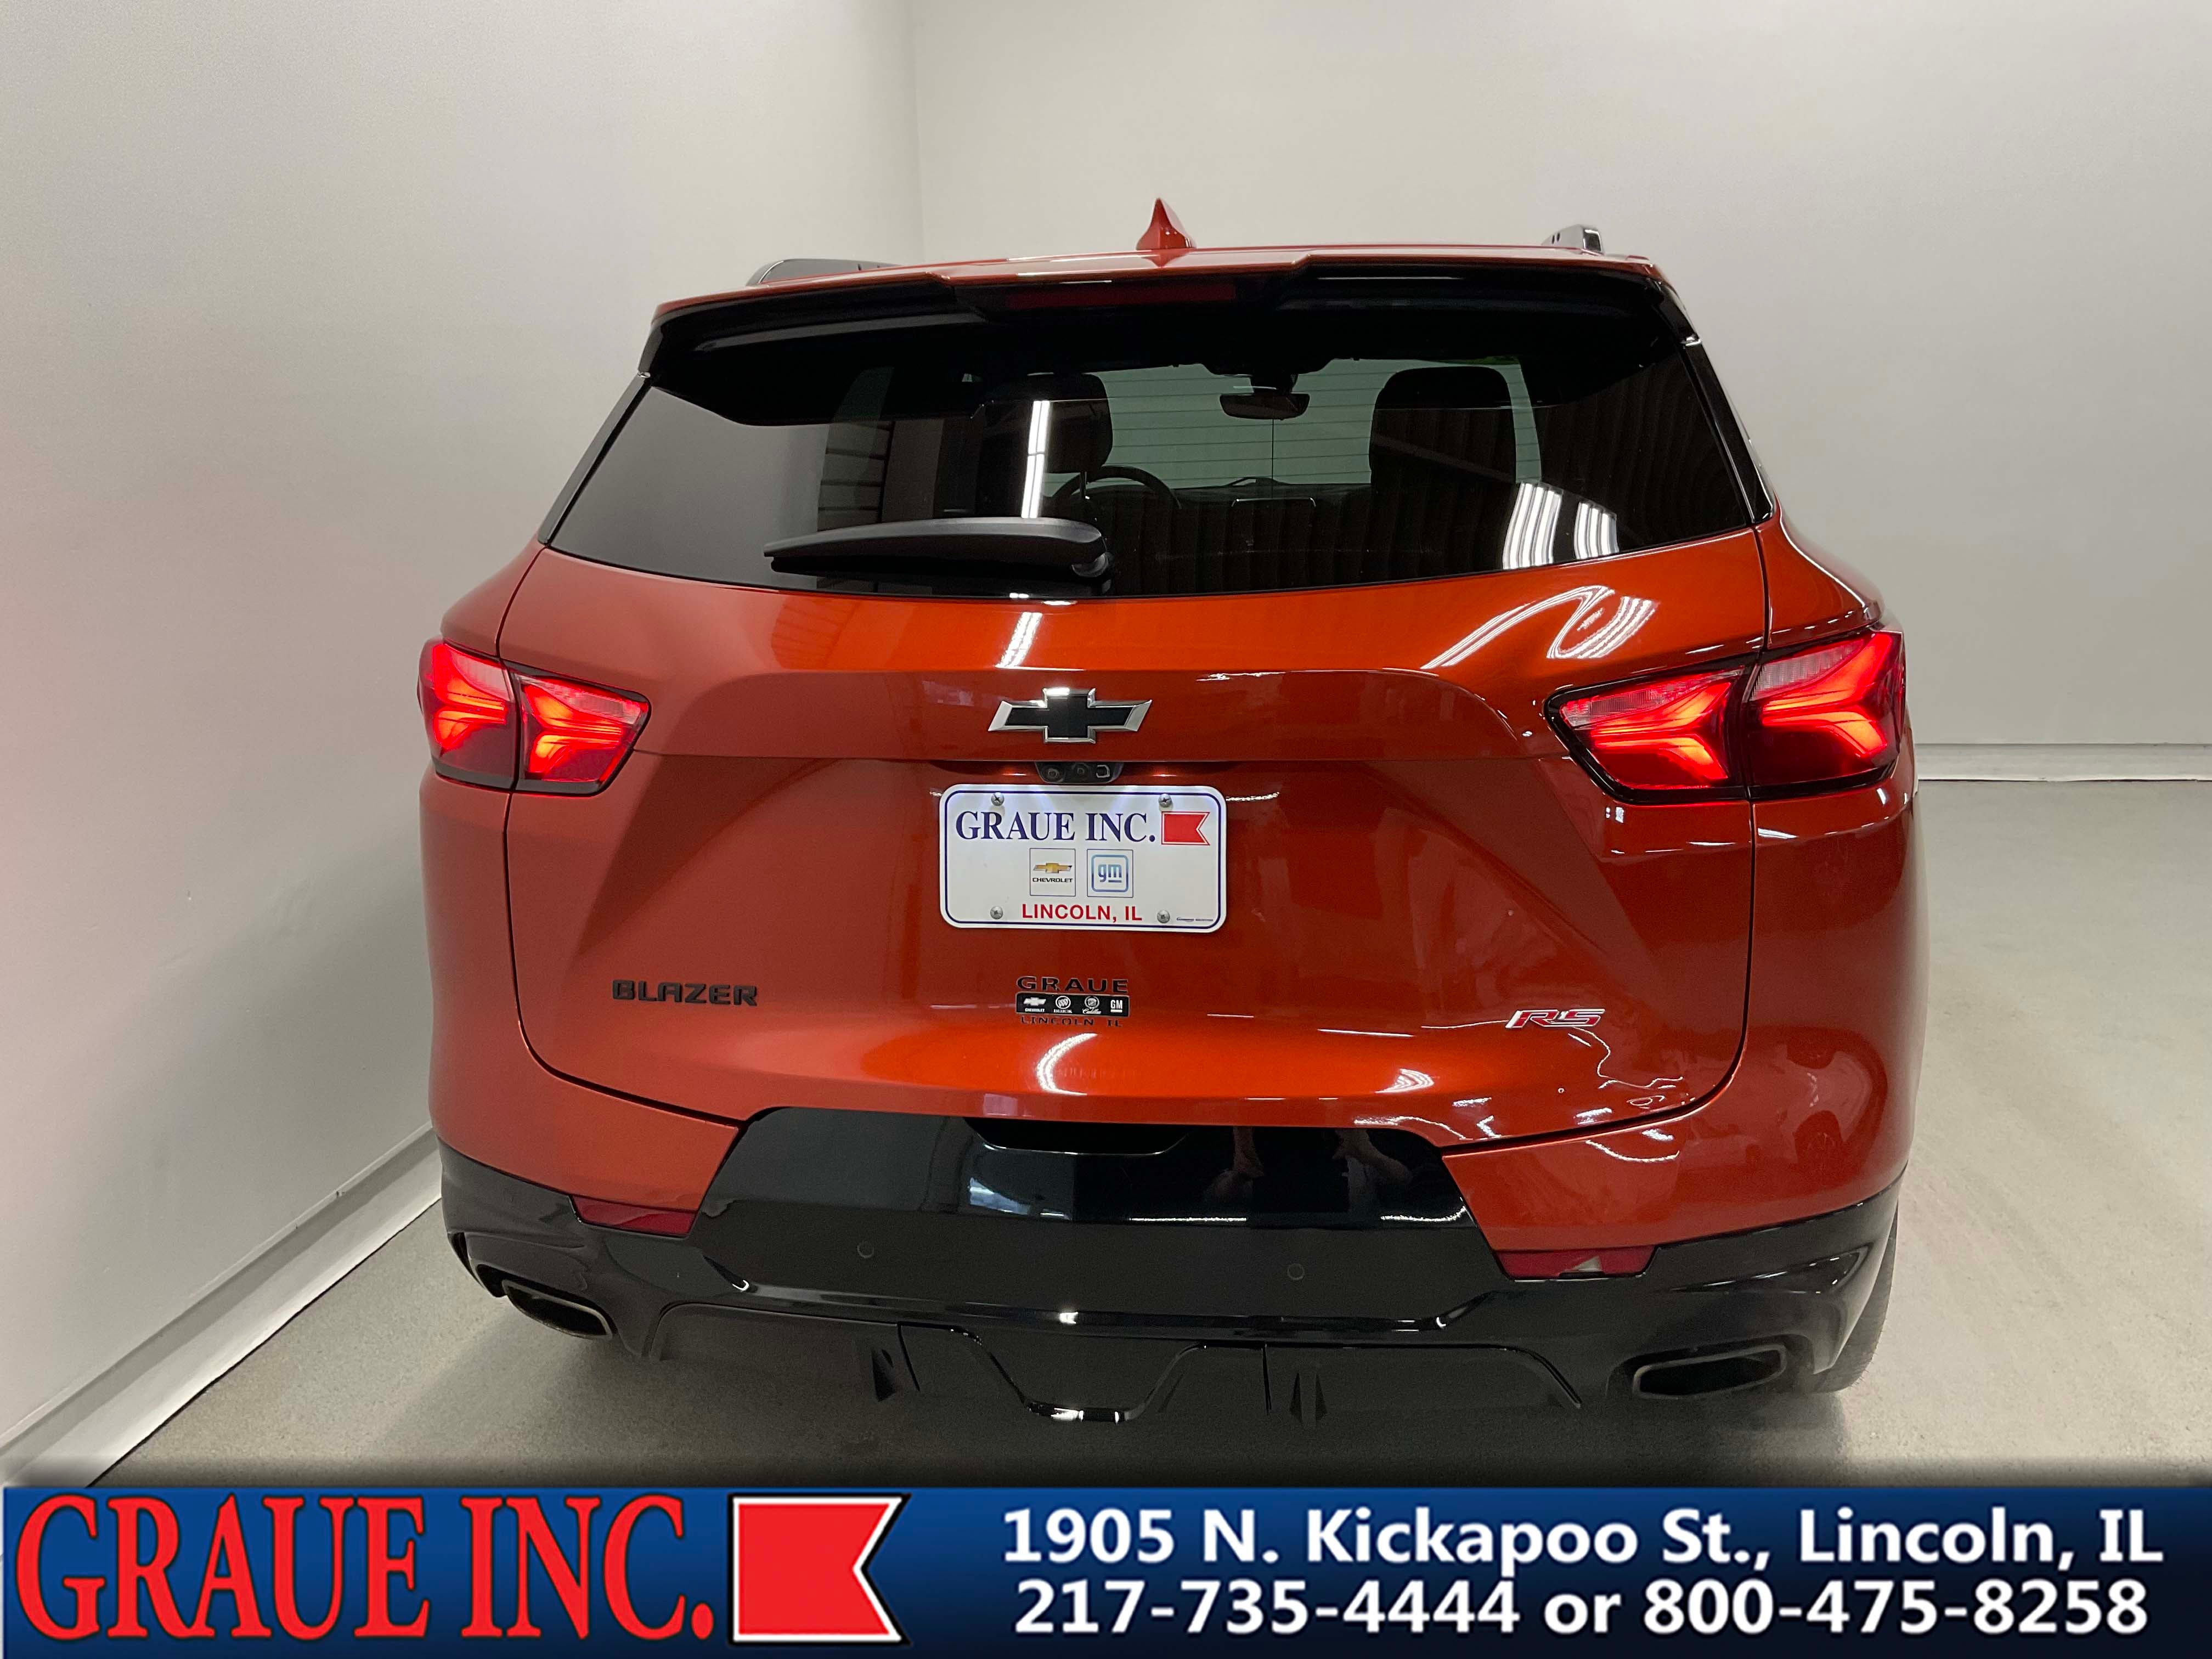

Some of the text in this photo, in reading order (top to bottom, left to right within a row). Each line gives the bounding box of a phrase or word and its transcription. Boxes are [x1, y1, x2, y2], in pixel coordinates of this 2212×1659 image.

[956, 811, 1155, 843] GRAUE INC.
[1098, 864, 1122, 883] gm
[1022, 904, 1143, 923] LINCOLN, IL
[612, 979, 758, 1006] BLAZER
[1017, 975, 1128, 993] GRAUE
[1110, 999, 1123, 1009] GM
[1020, 1015, 1124, 1028] LINCOLN IL
[1505, 1008, 1606, 1029] RS
